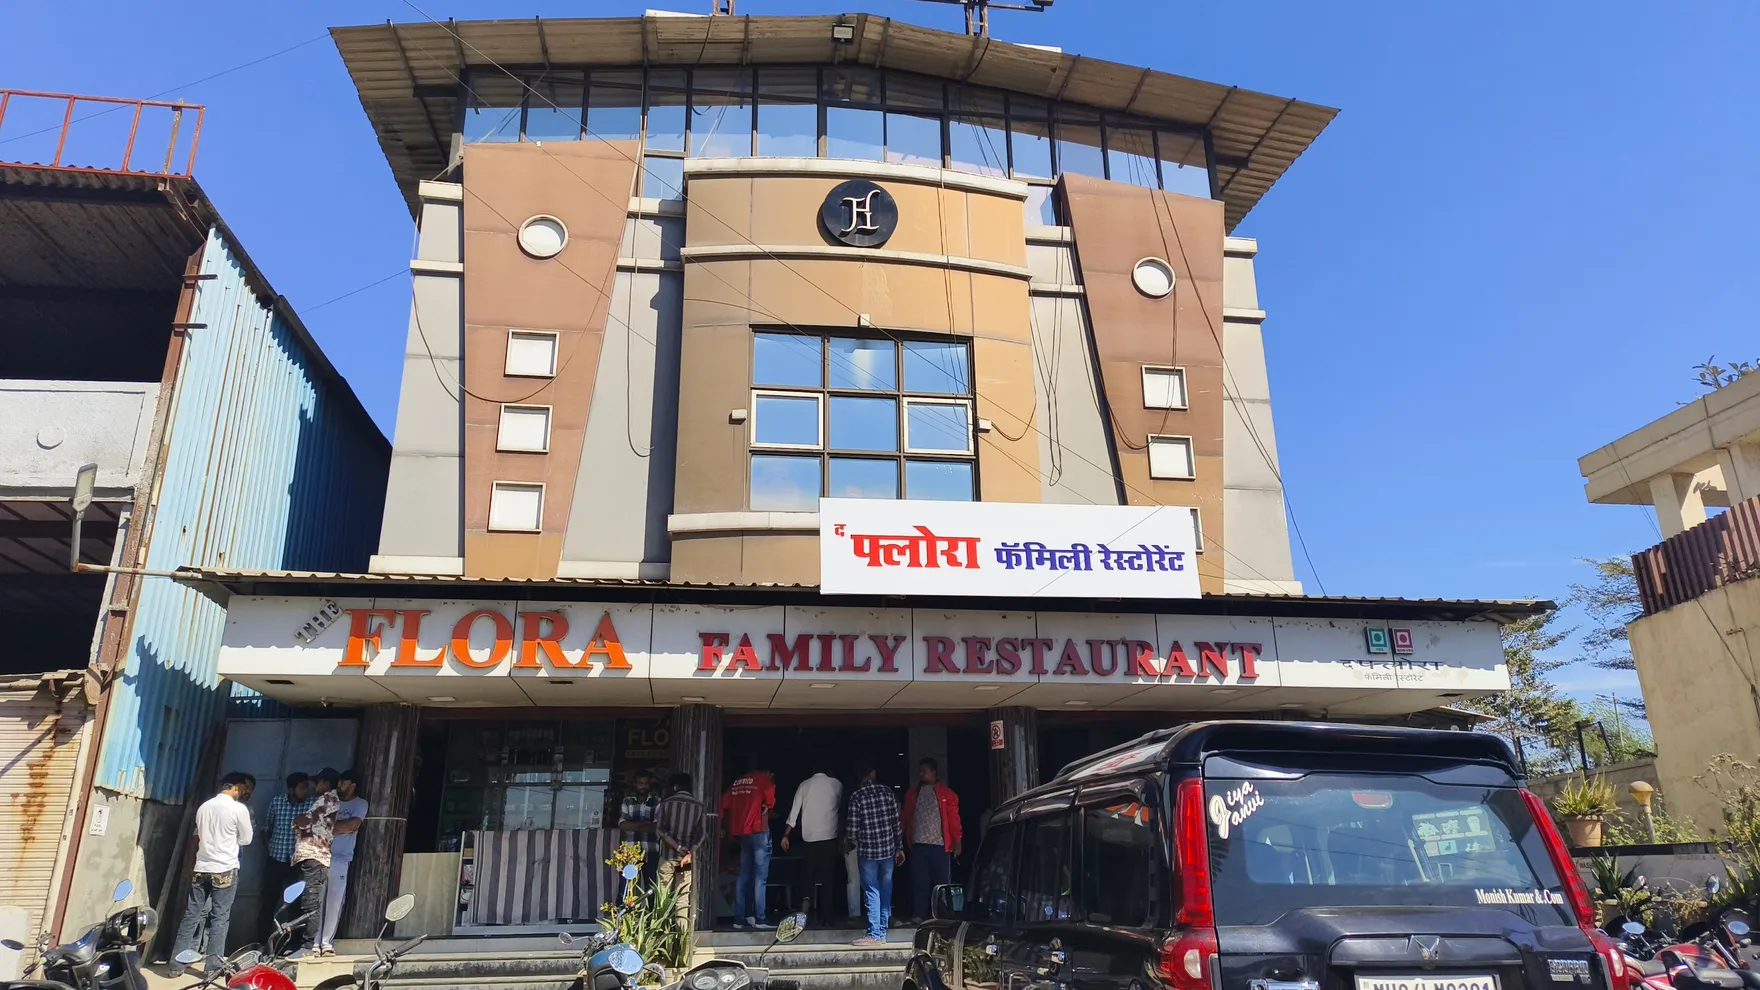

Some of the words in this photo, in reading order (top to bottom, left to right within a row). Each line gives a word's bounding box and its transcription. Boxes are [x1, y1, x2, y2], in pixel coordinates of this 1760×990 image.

[834, 523, 847, 537] द
[850, 525, 982, 569] फ्लोरा
[994, 541, 1093, 571] फॅमिली
[1096, 543, 1186, 572] रेस्टोरेंट
[294, 601, 344, 644] THE
[337, 608, 633, 669] FLORA
[697, 632, 907, 673] FAMILY
[923, 635, 1263, 679] RESTAURANT
[1475, 889, 1507, 904] Monish
[1505, 889, 1535, 904] Kumar
